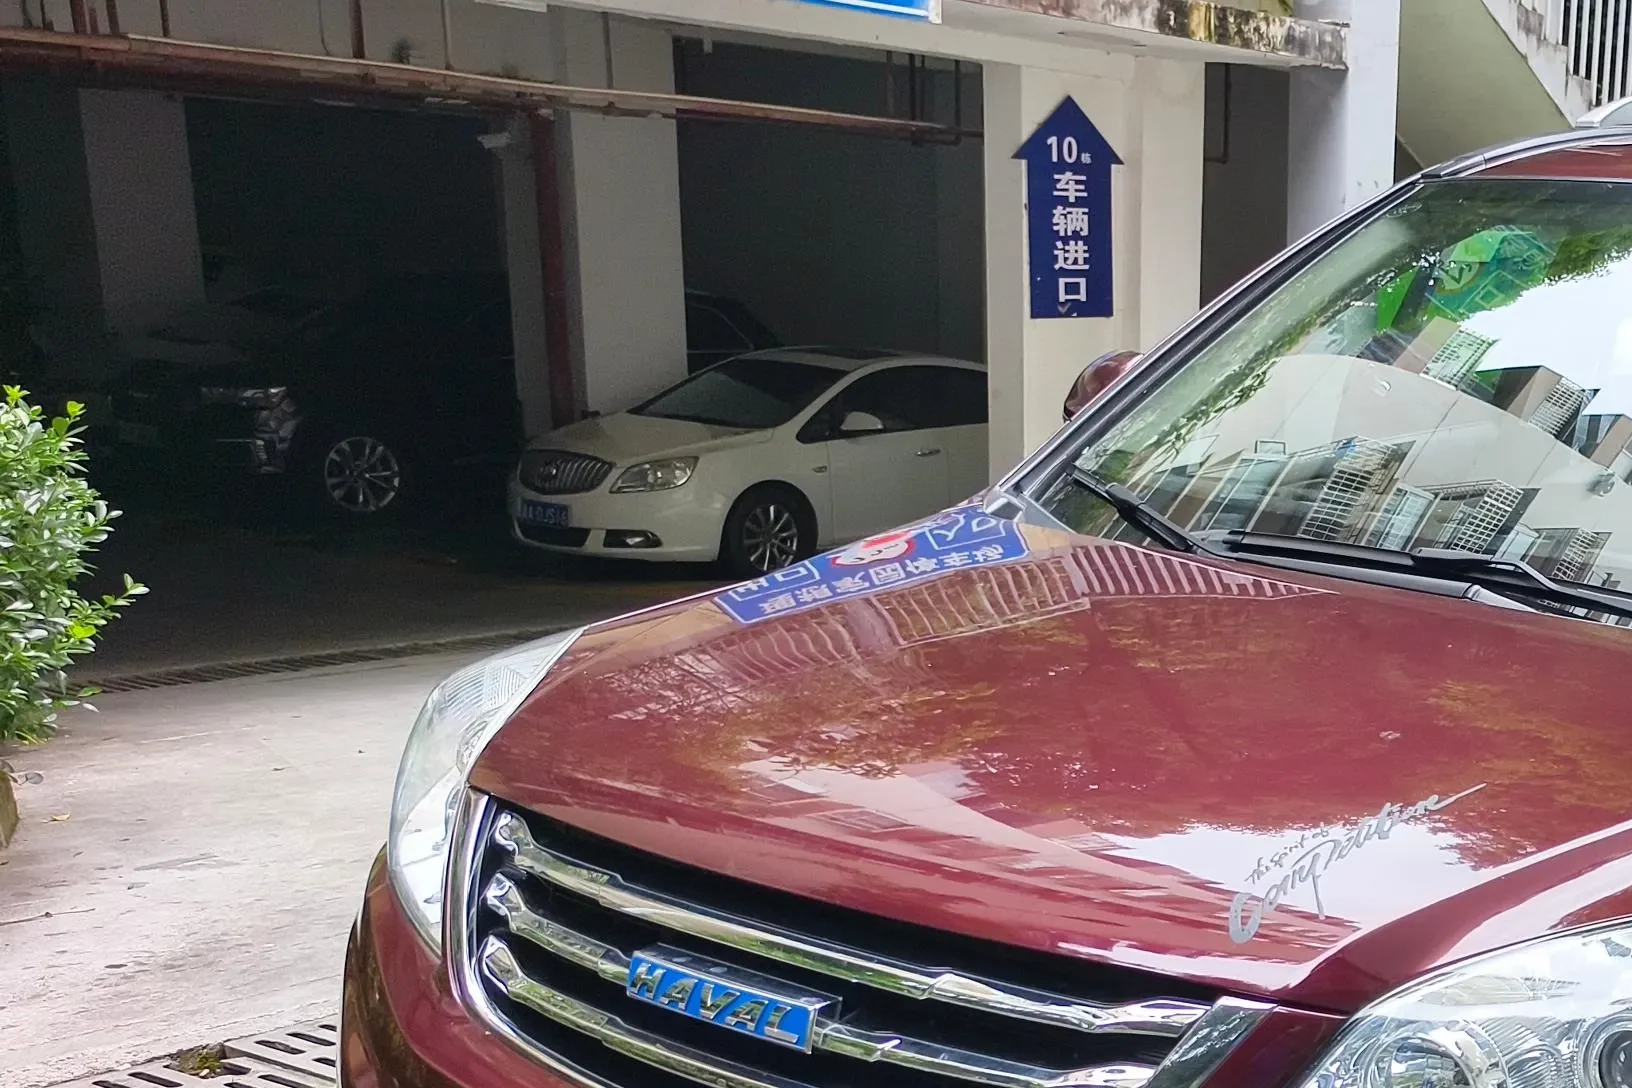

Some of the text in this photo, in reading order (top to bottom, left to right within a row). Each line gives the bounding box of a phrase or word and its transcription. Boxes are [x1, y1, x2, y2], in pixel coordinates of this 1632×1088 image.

[1052, 171, 1090, 302] 车辆进口
[629, 962, 800, 1045] HAVAL
